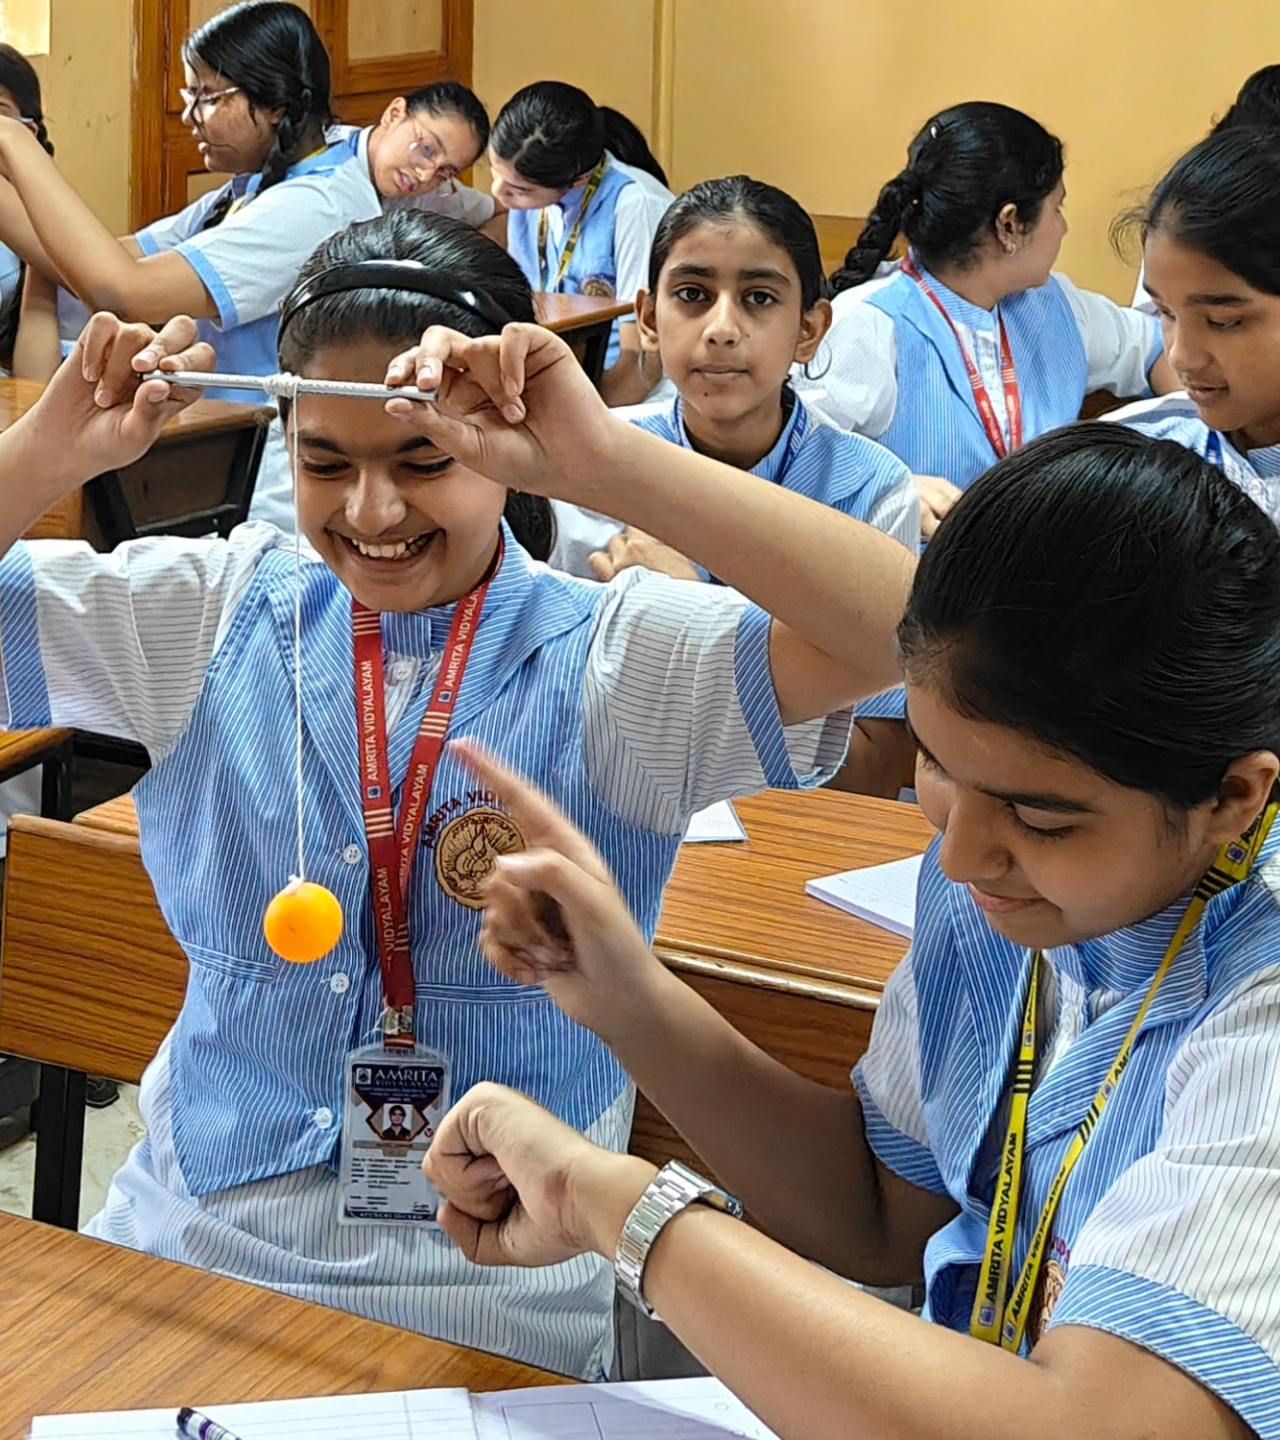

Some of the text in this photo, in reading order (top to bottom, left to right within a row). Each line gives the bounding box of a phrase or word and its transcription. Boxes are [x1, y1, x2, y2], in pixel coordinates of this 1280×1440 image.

[444, 642, 465, 688] AMRITA
[359, 659, 378, 783] AMRITA VIDYALAYAM
[400, 763, 429, 843] VIDYALAYAM
[422, 796, 464, 849] AMRITA
[376, 866, 394, 949] VIDYALAYAM
[375, 1069, 439, 1082] AMRITA
[984, 1132, 1019, 1303] AMRITA VIDYALAYAM
[1009, 1257, 1036, 1318] AMRITA
[1030, 1164, 1068, 1260] VIDYALAYAM
